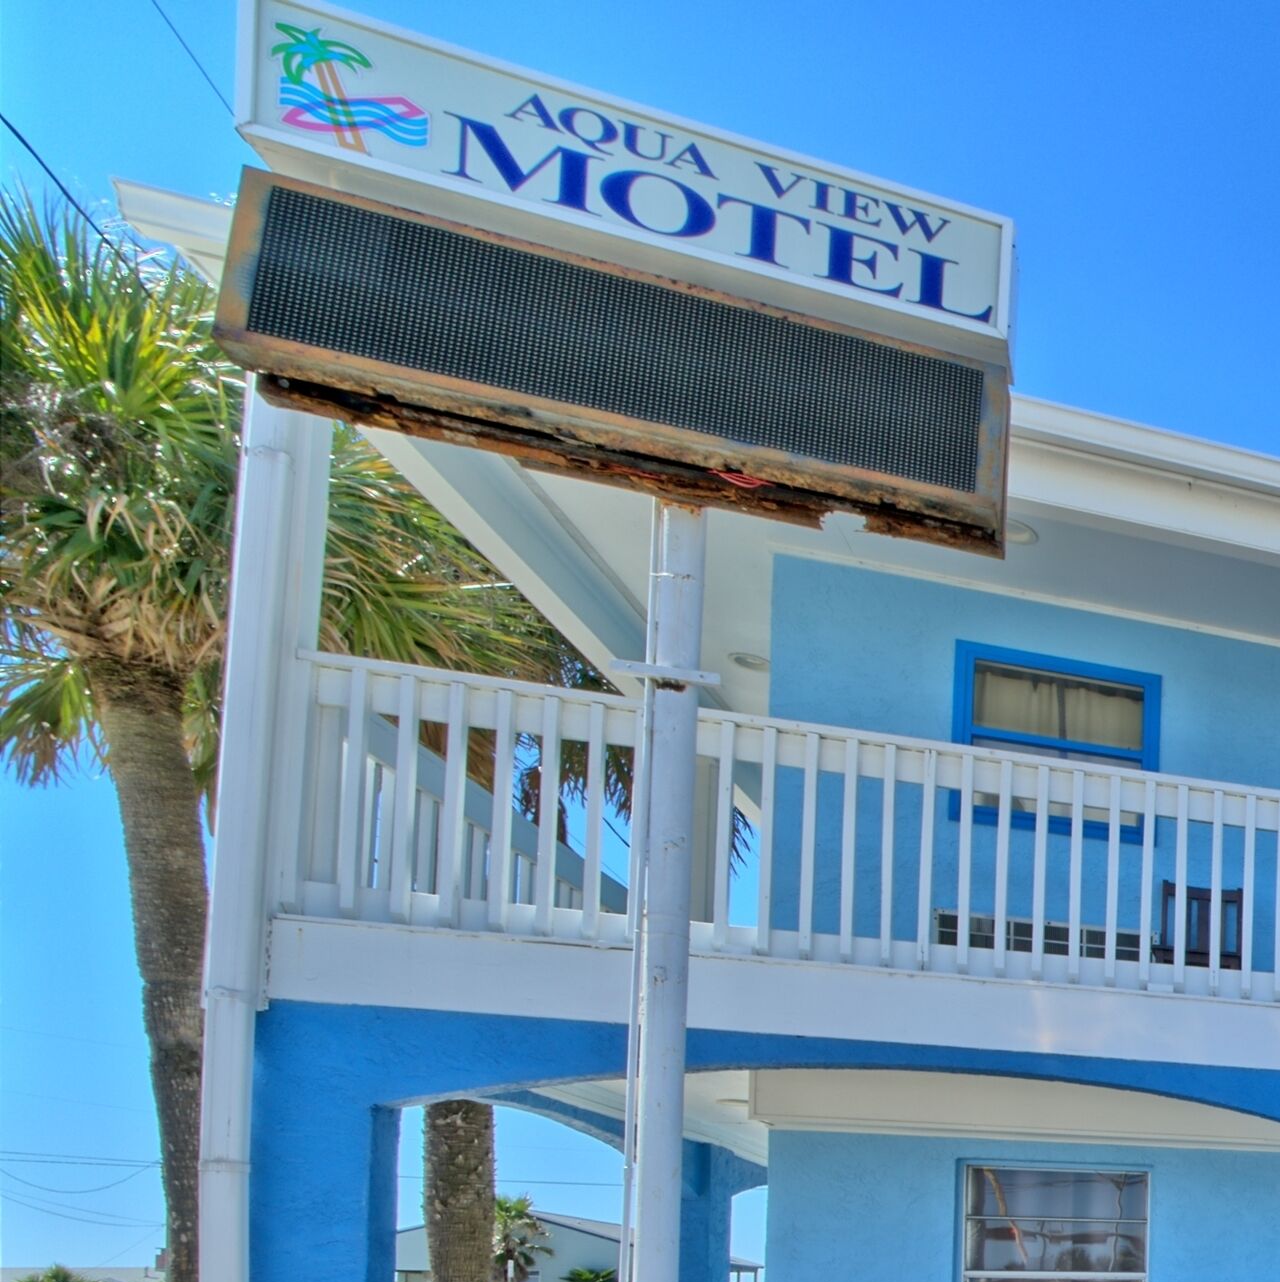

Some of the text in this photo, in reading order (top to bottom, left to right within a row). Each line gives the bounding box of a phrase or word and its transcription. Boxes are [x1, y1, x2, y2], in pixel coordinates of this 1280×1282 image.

[439, 109, 995, 324] MOTEL
[508, 93, 952, 244] AQUA VIEW
